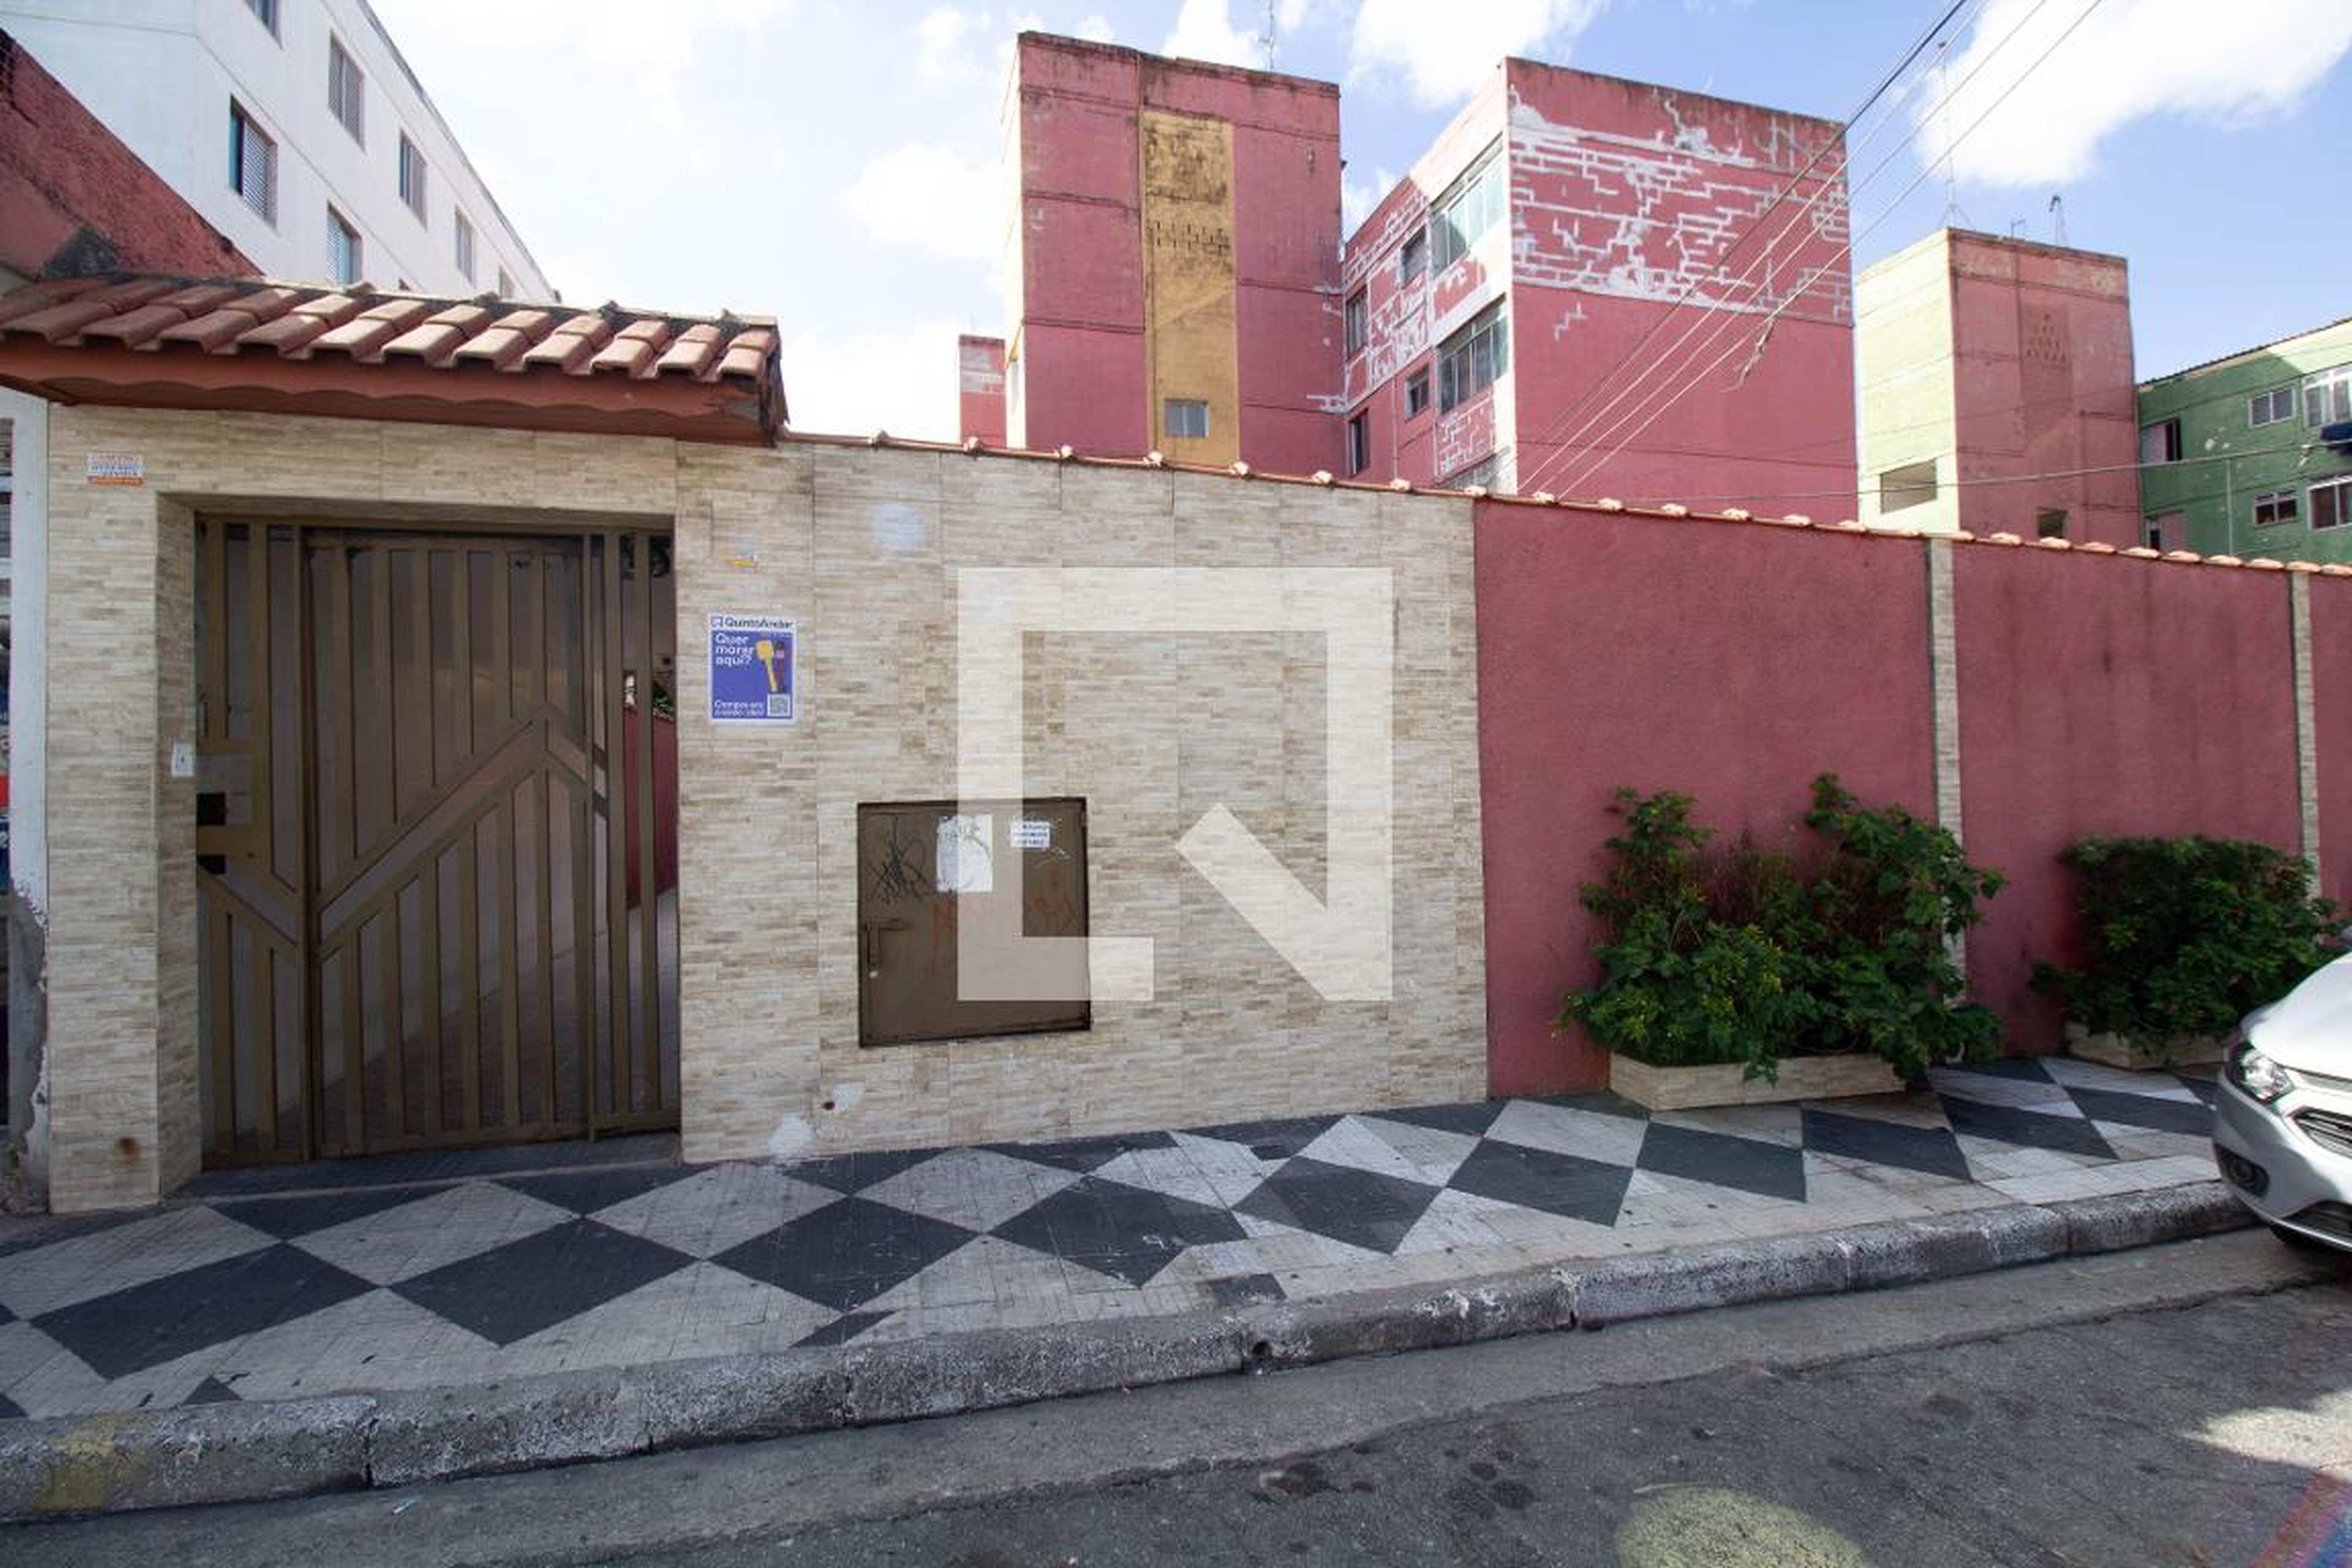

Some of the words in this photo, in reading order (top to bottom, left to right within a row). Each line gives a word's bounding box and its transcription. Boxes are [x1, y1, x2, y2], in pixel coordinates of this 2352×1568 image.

[715, 633, 748, 645] Quer
[715, 646, 754, 655] morar
[715, 655, 752, 667] aqui?
